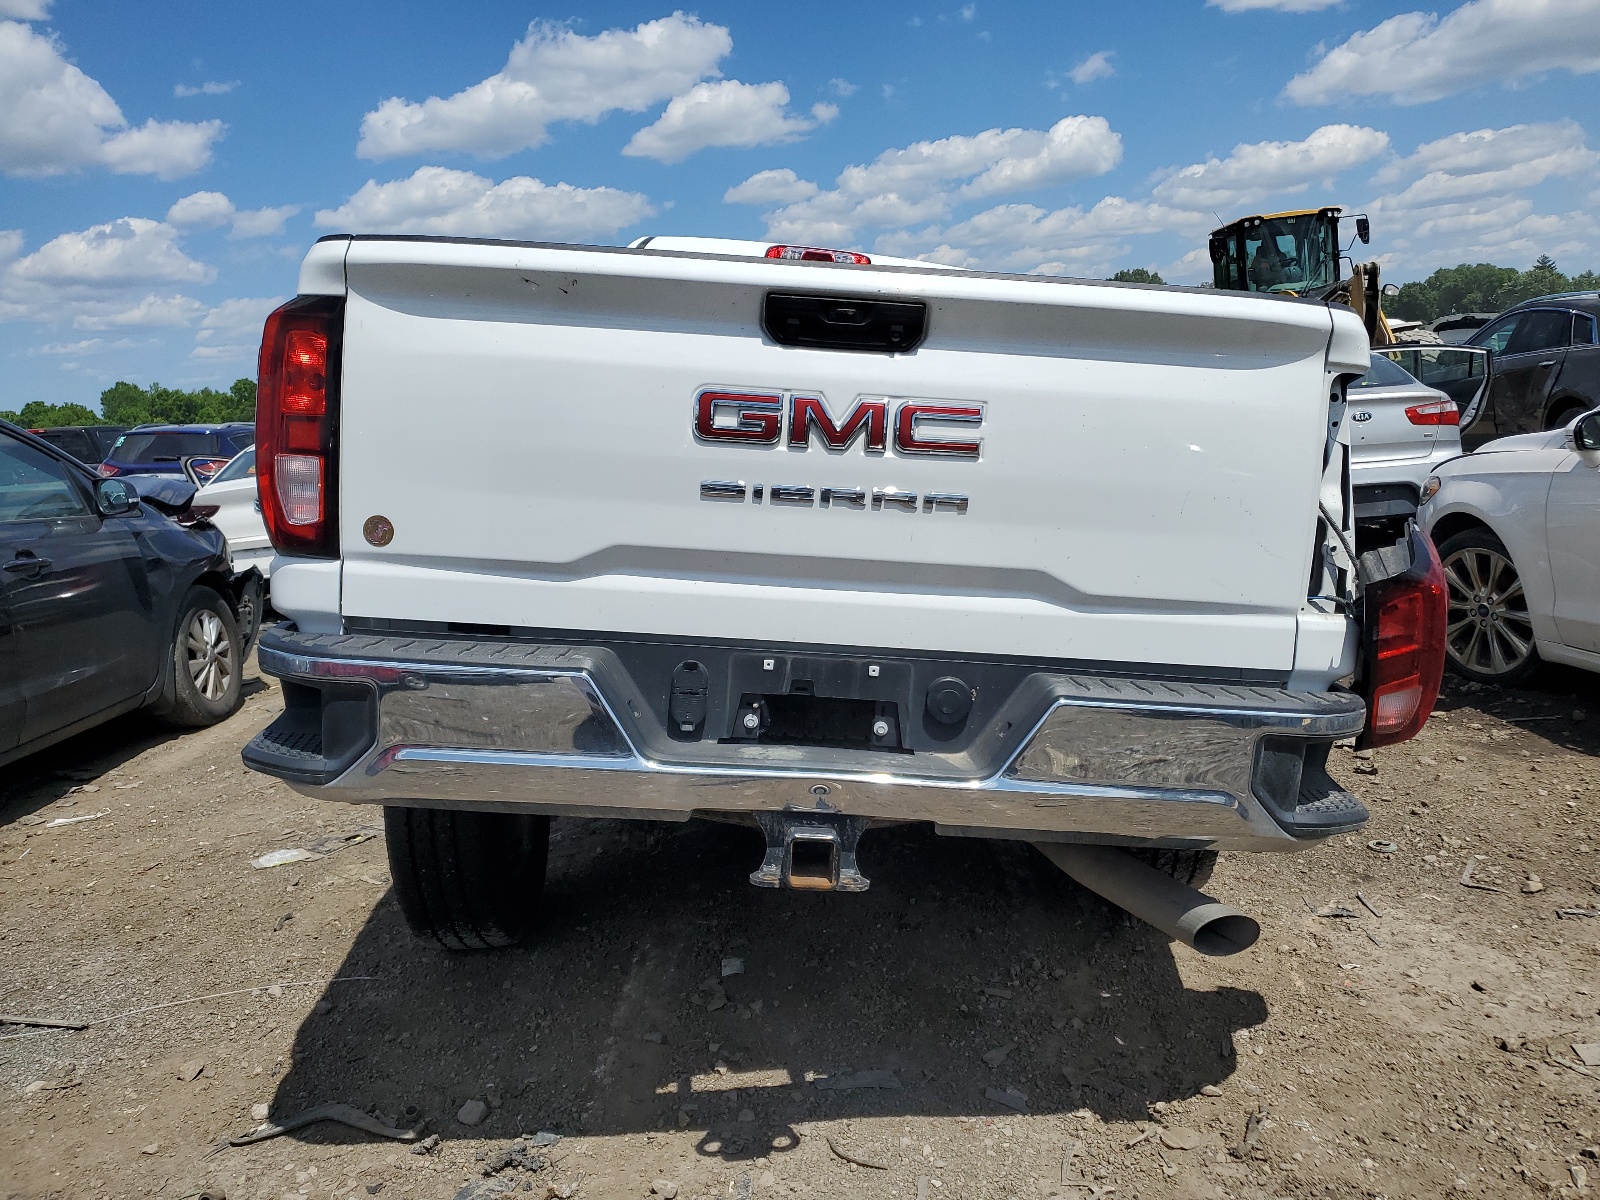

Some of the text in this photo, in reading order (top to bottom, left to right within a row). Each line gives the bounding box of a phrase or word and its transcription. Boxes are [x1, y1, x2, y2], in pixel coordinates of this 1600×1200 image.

[693, 385, 985, 460] GMC
[1354, 412, 1370, 421] KIA
[700, 480, 969, 515] SIERRA
